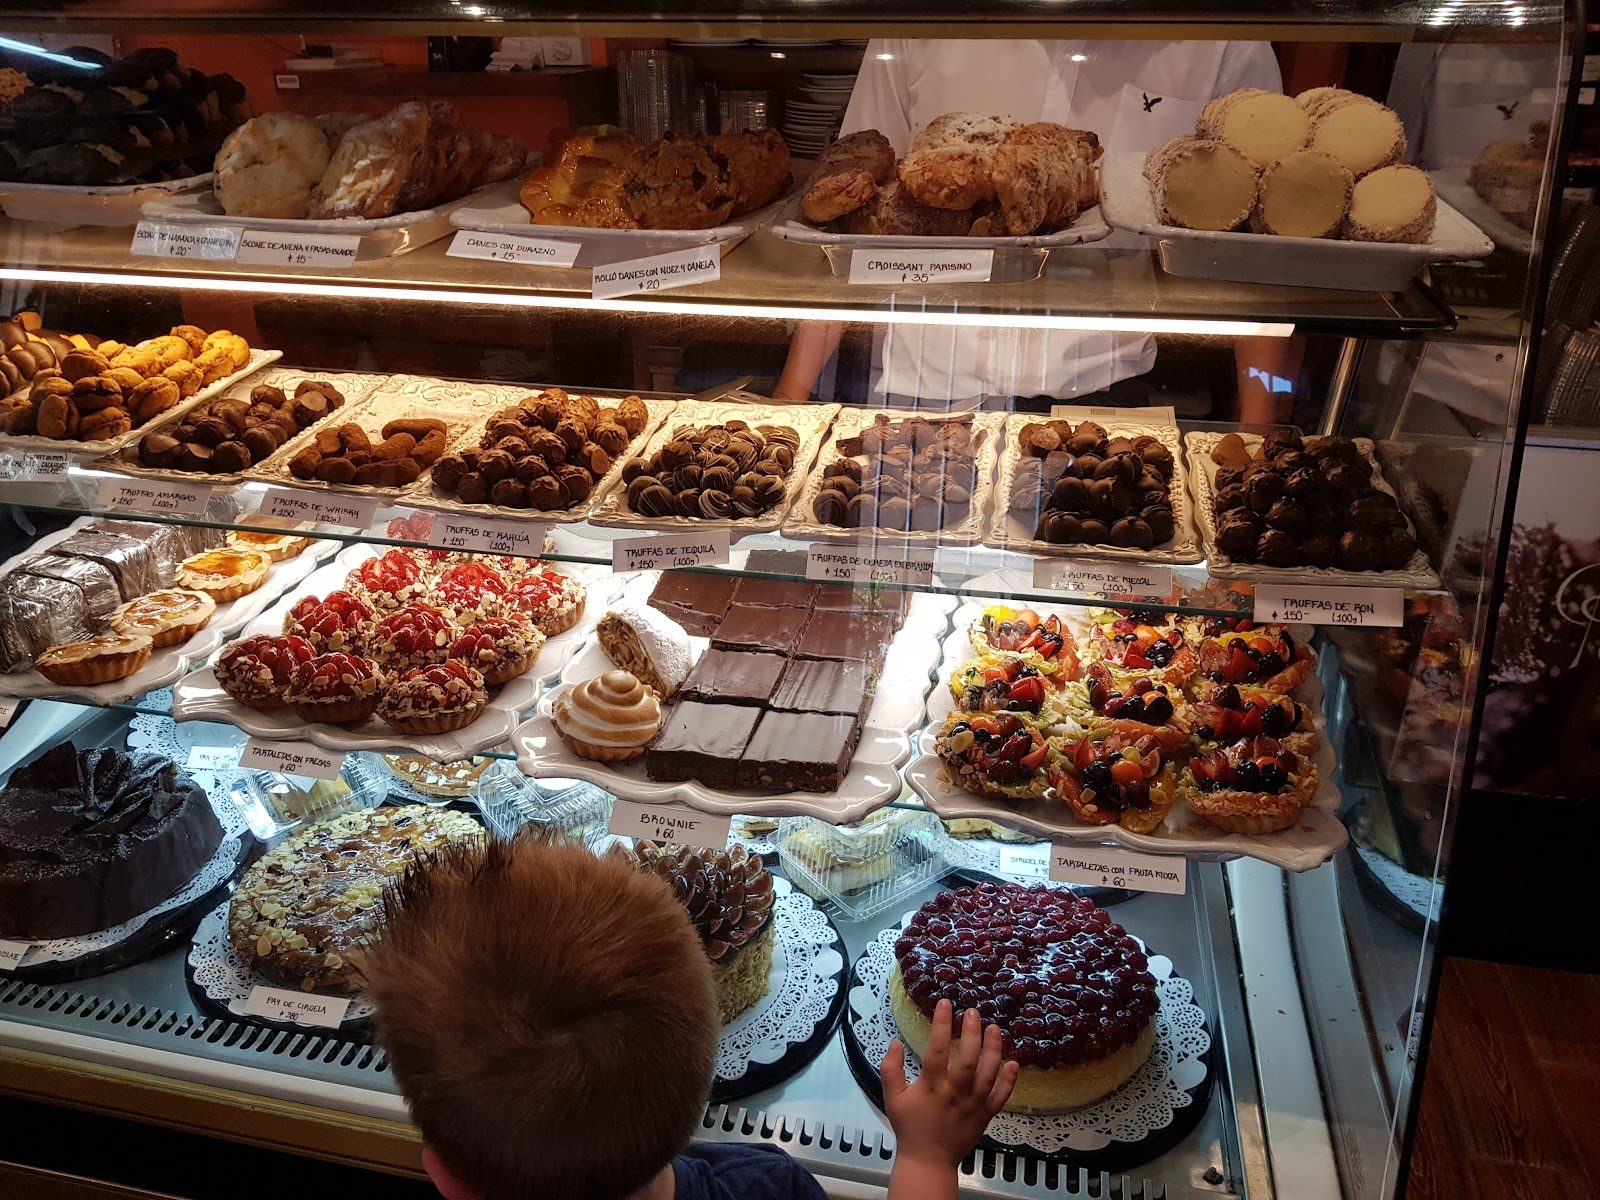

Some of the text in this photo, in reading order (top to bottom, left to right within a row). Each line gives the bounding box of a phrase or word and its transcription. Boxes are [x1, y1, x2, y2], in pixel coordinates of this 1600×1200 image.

[136, 230, 157, 240] SCON
[158, 232, 167, 240] DE
[241, 239, 266, 249] SCONE
[268, 242, 278, 250] DE
[277, 243, 303, 252] AVENA
[309, 245, 331, 254] PASAS
[466, 239, 498, 248] DANES
[516, 245, 556, 255] DURAZNO
[594, 272, 617, 283] ROLLO
[618, 270, 644, 280] DANES
[645, 268, 658, 276] CON
[660, 265, 680, 275] NUEZ
[687, 260, 716, 272] CANELA
[868, 260, 972, 271] CROISSANT PARISINO
[120, 488, 196, 501] TRUFFAS AMARGAS
[273, 497, 309, 509] TRUFFAS
[326, 506, 360, 519] WHISKY
[445, 525, 479, 536] TRUFFAS
[482, 530, 494, 538] DE
[625, 544, 716, 558] TRUFFAS DE TEQUILA
[810, 553, 933, 573] TRUFFAS DE CEREZA EN BRANDY
[1063, 571, 1157, 586] TRUFFAS DE MEZCAL
[1280, 598, 1374, 613] TRUFFAS DE RON
[252, 747, 332, 768] TARTALETAS CON FRESAS
[640, 813, 701, 829] BROWNIE
[1057, 857, 1109, 873] TARTALETAS
[1129, 867, 1154, 878] FRUTA
[1155, 871, 1180, 882] MIXTA
[266, 996, 280, 1006] PAY
[297, 1002, 326, 1015] CIRUELA
